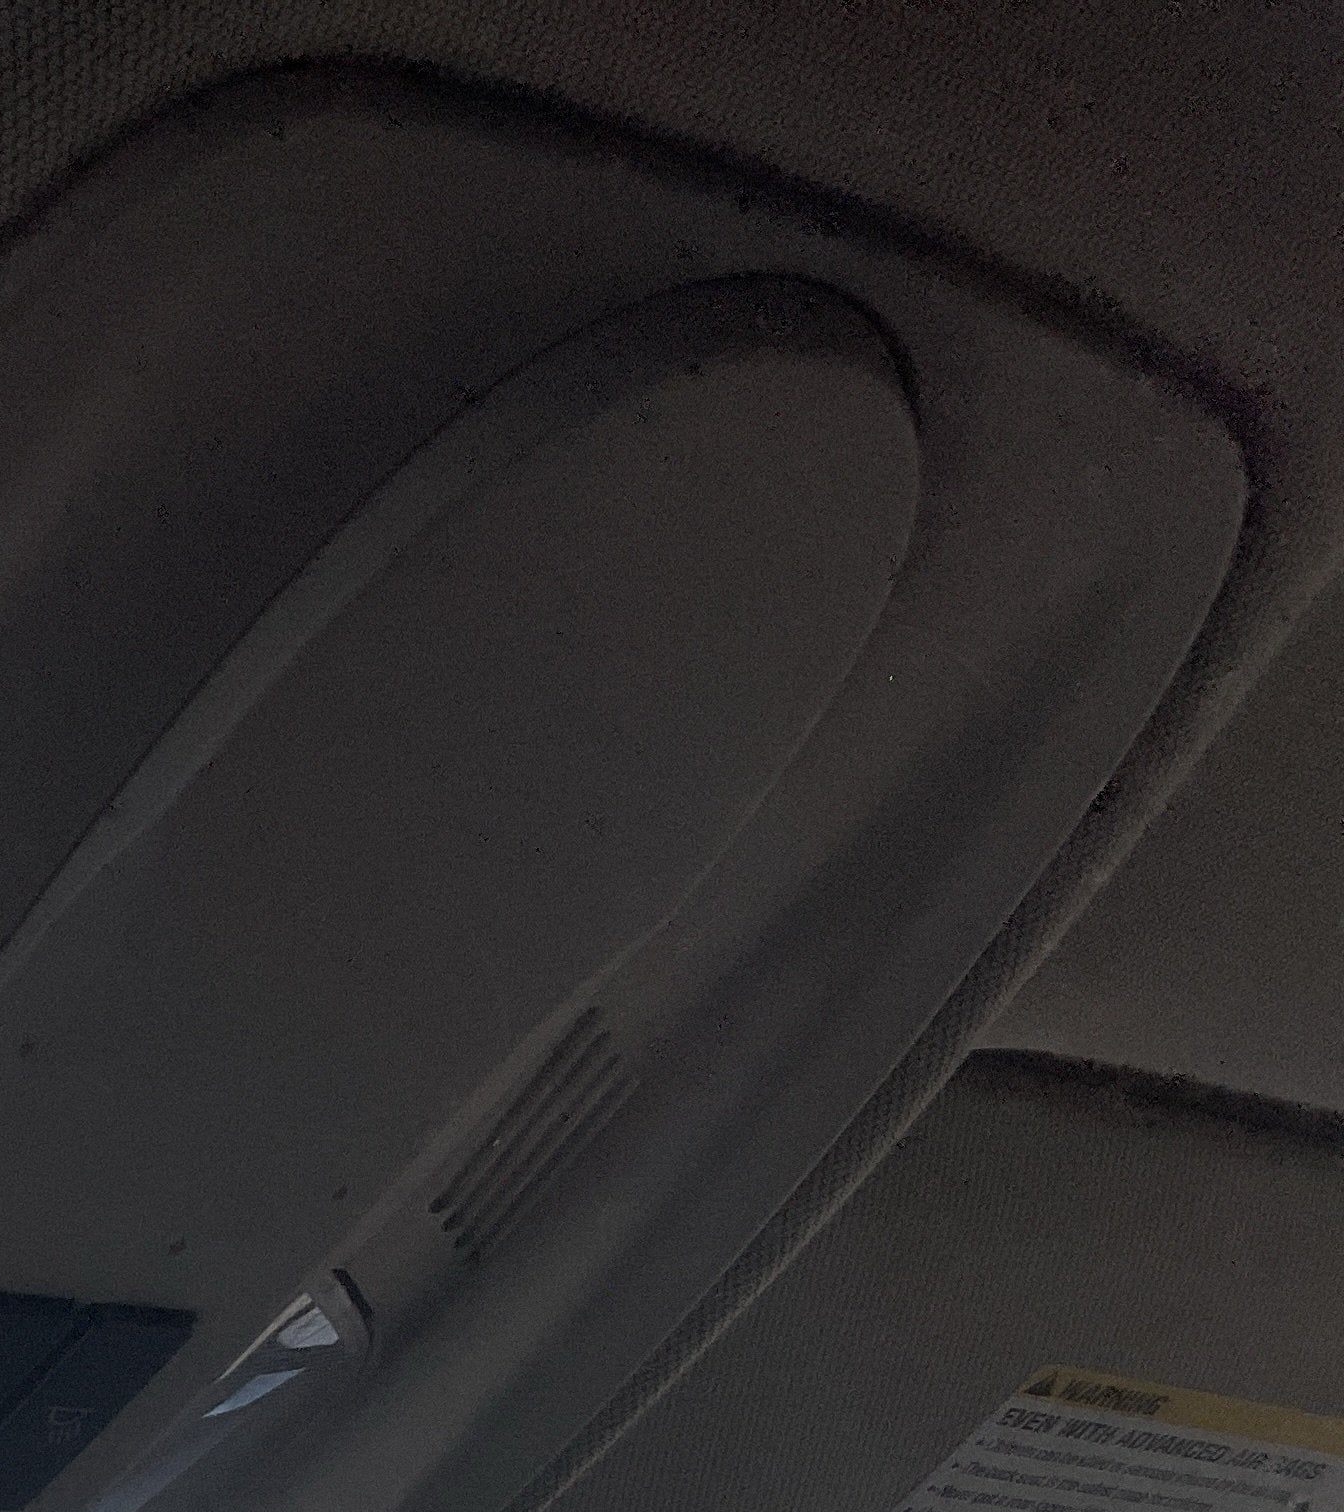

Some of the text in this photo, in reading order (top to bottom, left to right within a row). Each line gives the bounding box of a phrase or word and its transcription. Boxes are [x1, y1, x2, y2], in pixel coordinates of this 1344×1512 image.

[996, 1407, 1061, 1434] EVEN
[1058, 1417, 1119, 1444] WITH
[1116, 1429, 1232, 1461] ADVANCED
